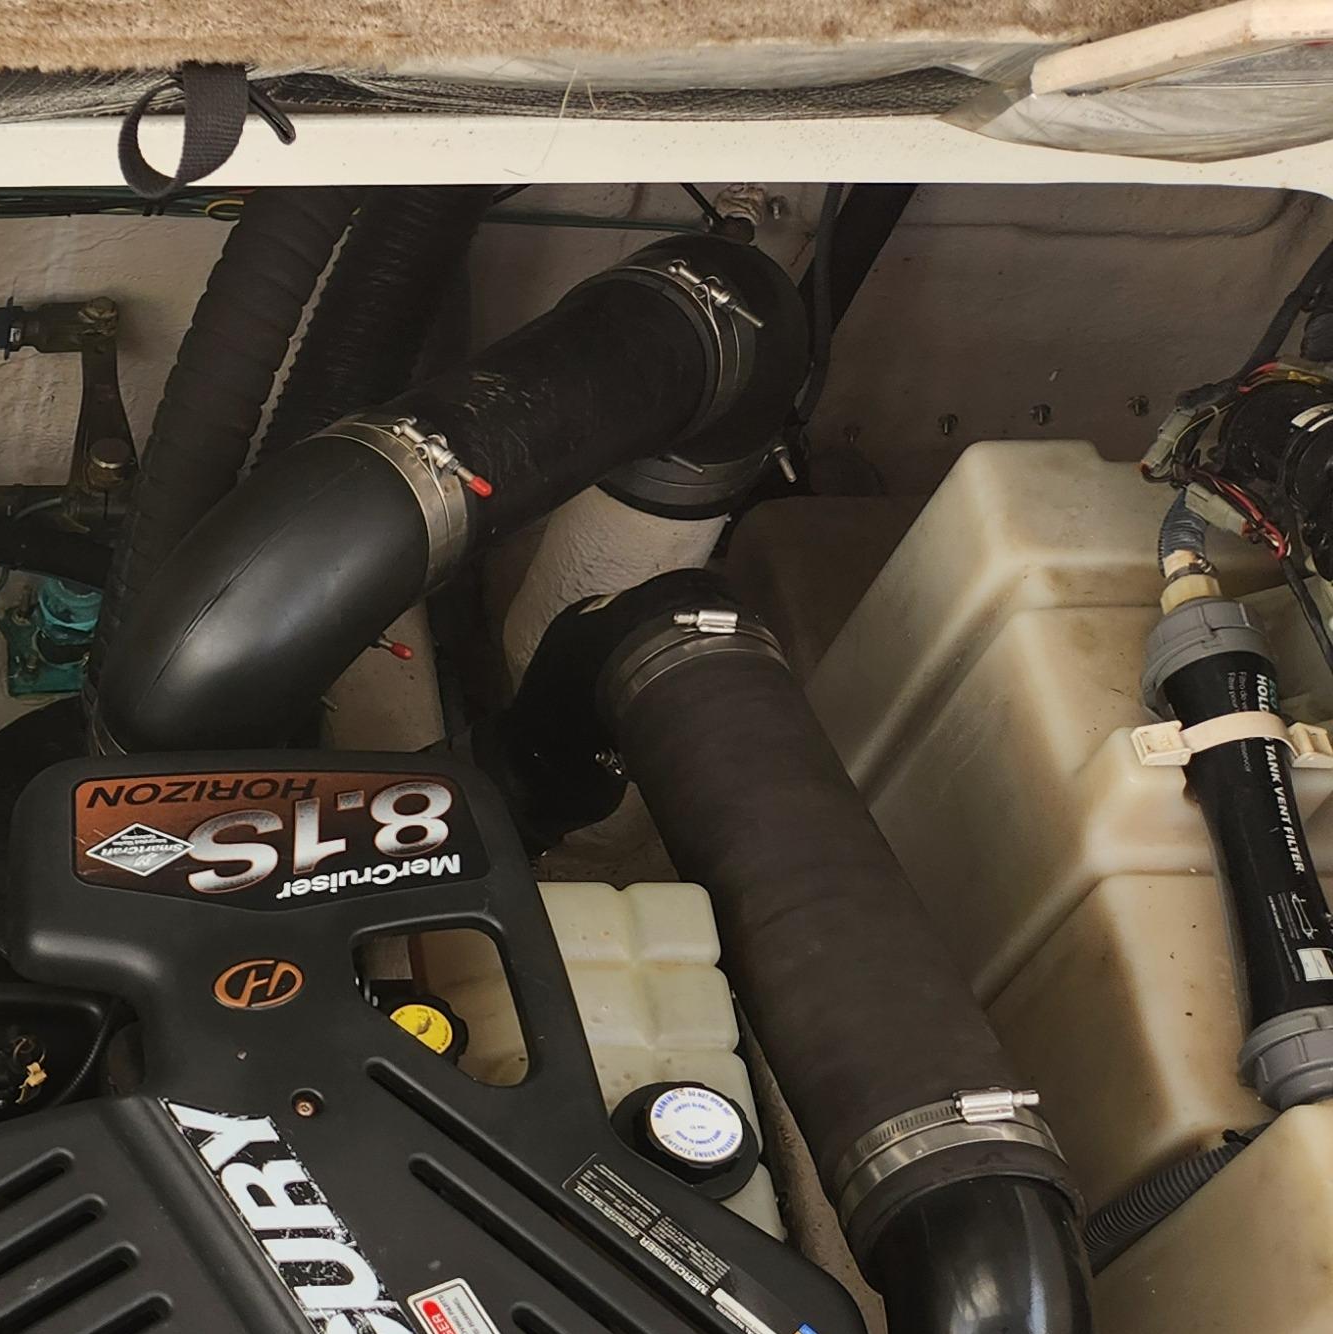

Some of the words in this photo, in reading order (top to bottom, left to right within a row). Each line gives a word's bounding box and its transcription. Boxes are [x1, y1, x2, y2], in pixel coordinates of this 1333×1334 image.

[1263, 742, 1283, 786] TANK
[84, 777, 318, 808] HORIZON
[1272, 784, 1292, 825] VENT
[100, 842, 184, 856] SmartCraft
[187, 780, 452, 893] 8.1S
[274, 852, 461, 900] MerCruiser
[637, 1235, 710, 1295] MERCRUISER
